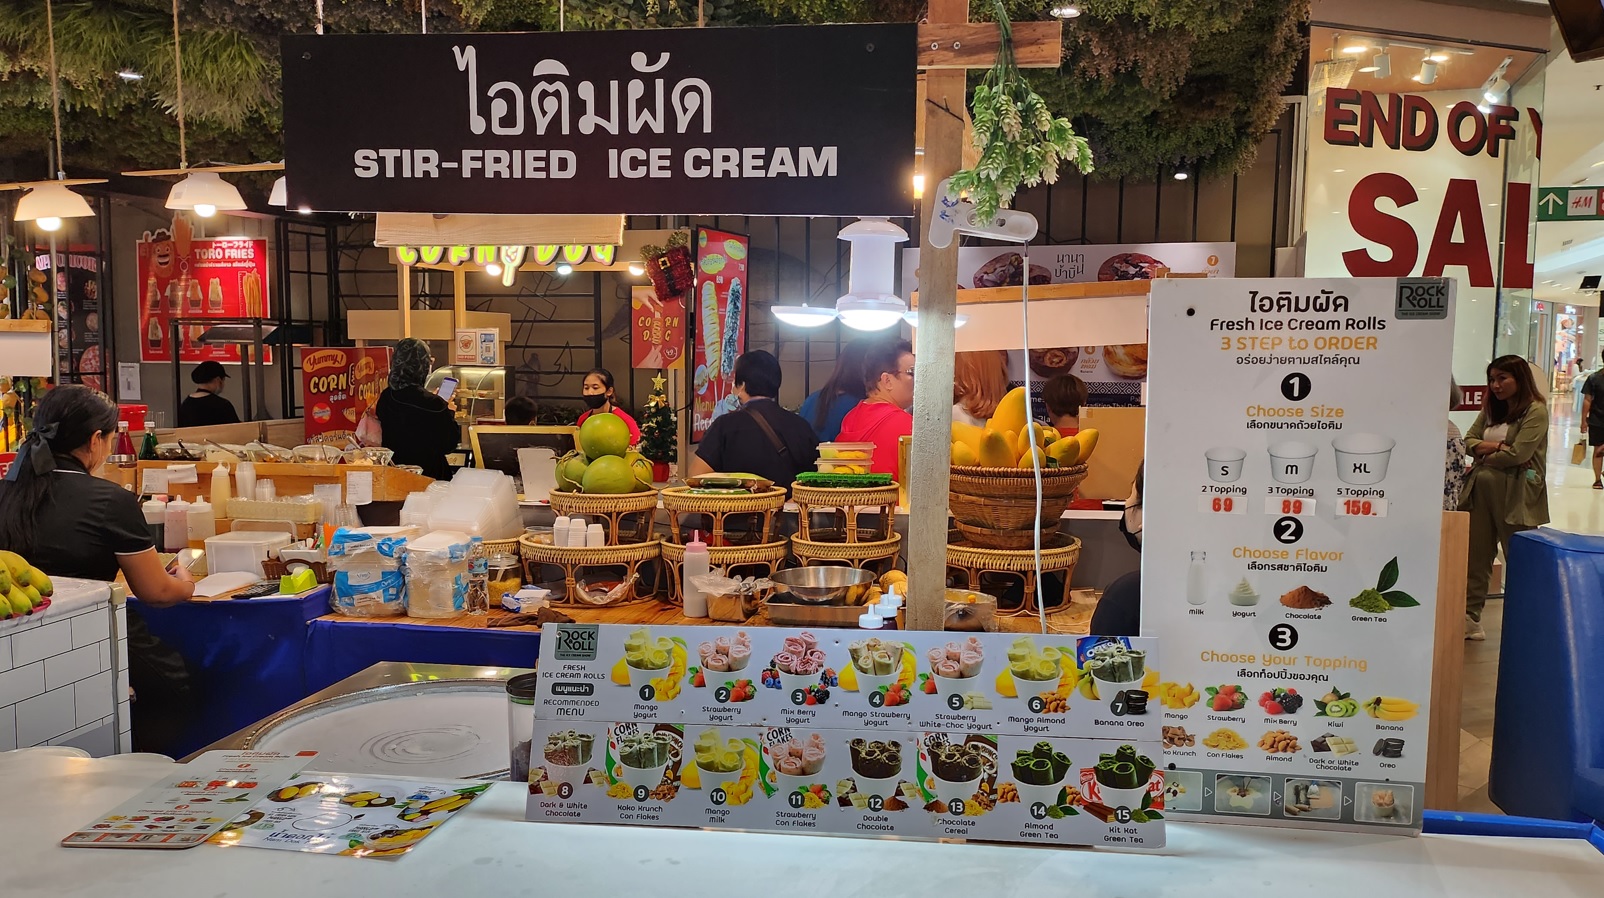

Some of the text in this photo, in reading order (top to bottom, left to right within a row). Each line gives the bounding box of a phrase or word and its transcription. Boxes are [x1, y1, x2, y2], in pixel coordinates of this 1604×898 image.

[452, 45, 712, 136] ไอติมผัด
[1324, 87, 1439, 151] END
[1447, 101, 1519, 158] OF
[354, 146, 838, 180] STIR-FRIED ICE CREAM
[194, 248, 254, 259] TORO FRIES
[1250, 290, 1348, 312] ไอติมผัด
[1210, 317, 1386, 331] Fresh Ice Cream Rolls
[1220, 336, 1378, 350] 3 STEP to ORDER
[306, 354, 344, 370] Yummy!
[1236, 354, 1360, 368] อร่อยง่ายตามสไตล์คุณ
[310, 373, 346, 394] CORN
[1288, 377, 1300, 397] 1
[1246, 404, 1344, 418] Choose Size
[1246, 420, 1342, 430] เลือกขนาดถ้วยไอติม
[1220, 465, 1229, 476] S
[1352, 462, 1370, 474] XL
[1208, 486, 1247, 495] Topping
[1276, 486, 1314, 496] Topping
[1345, 488, 1384, 498] Topping
[1212, 497, 1233, 512] 69
[1282, 500, 1303, 514] 89
[1280, 520, 1296, 540] 2
[1232, 547, 1344, 561] Choose Flavor
[1247, 562, 1328, 573] เลือกรสชาติไอติม
[1285, 612, 1322, 620] Chocolate
[1276, 628, 1292, 646] 3
[1200, 651, 1256, 664] Choose
[1304, 656, 1368, 672] Topping
[1237, 668, 1329, 683] เลือกท็อปปิ้งของคุณ
[556, 708, 585, 716] MENU
[634, 704, 658, 712] Mango
[702, 706, 742, 715] Strawberry
[780, 708, 816, 718] Mix Berry
[633, 711, 658, 720] Yogurt
[709, 712, 734, 722] Yogurt
[786, 716, 810, 725] Yogurt
[842, 711, 910, 720] Mango Strawberry
[935, 714, 976, 723] Strawberry
[1008, 716, 1066, 724] Mango Almond
[1164, 712, 1188, 721] Mango
[1208, 714, 1246, 724] Strawberry
[864, 718, 888, 728] Yogurt
[966, 722, 992, 731] Yogurt
[1094, 718, 1144, 728] Banana Oreo
[1278, 718, 1298, 726] Berry
[614, 723, 638, 736] CORN
[1024, 724, 1050, 733] Yogurt
[1376, 724, 1404, 732] Banana
[766, 728, 790, 742] CORN
[1222, 752, 1244, 760] Flakes
[1309, 758, 1326, 766] Dark
[1338, 760, 1359, 768] White
[1316, 764, 1352, 772] Chocolate
[1380, 762, 1396, 770] Oreo
[540, 802, 556, 810] Dark
[637, 805, 663, 813] Krunch
[545, 810, 580, 818] Chocolate
[636, 813, 660, 821] Flakes
[705, 808, 730, 817] Mango
[776, 811, 816, 820] Strawberry
[792, 820, 816, 828] Flakes
[863, 815, 888, 823] Double
[857, 823, 894, 831] Chocolate
[1024, 822, 1054, 830] Almond
[1109, 826, 1138, 835] Kit Kat
[1104, 835, 1144, 844] Green Tea
